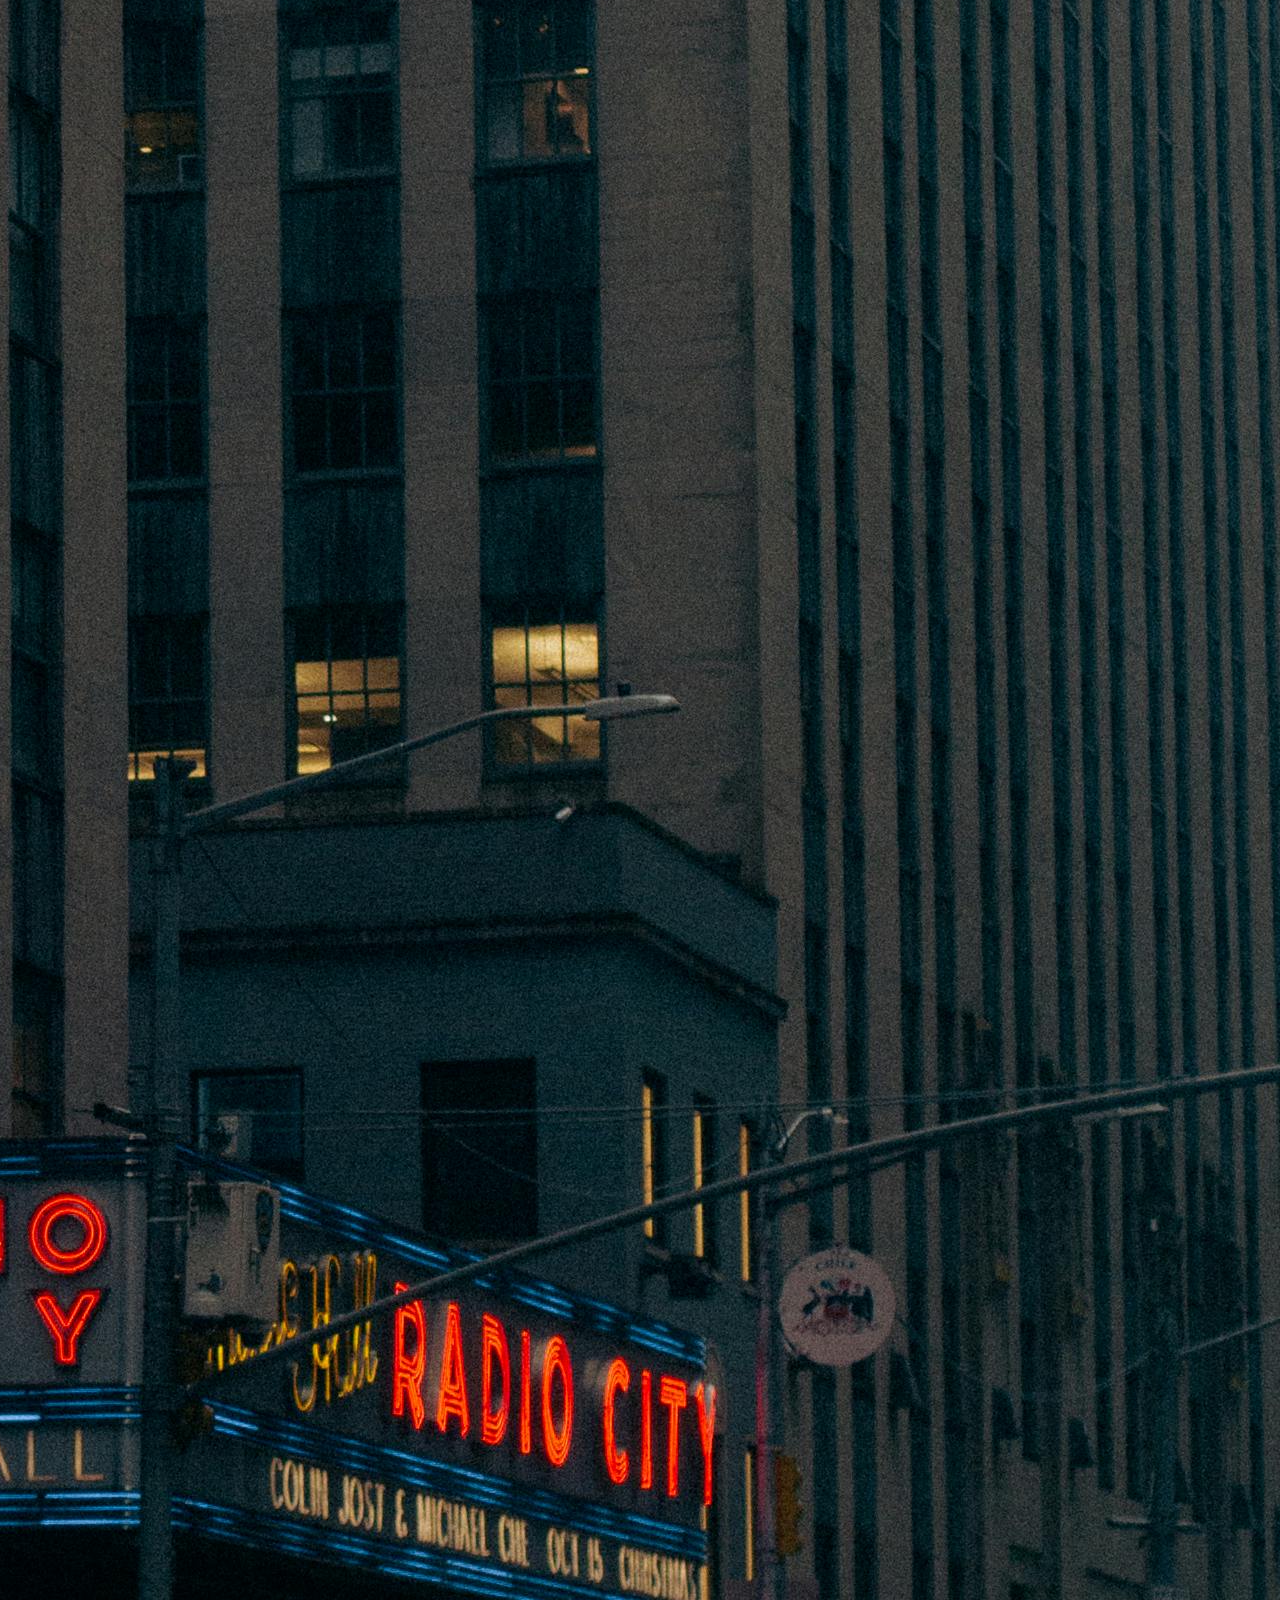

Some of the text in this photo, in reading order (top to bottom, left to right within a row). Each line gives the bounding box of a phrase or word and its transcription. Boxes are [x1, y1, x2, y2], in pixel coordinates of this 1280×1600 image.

[391, 1281, 575, 1468] RADIO
[602, 1356, 717, 1507] CITY
[269, 1456, 330, 1521] COLIN
[337, 1473, 385, 1534] JOST
[416, 1488, 490, 1557] MICHAEL
[497, 1512, 530, 1568] CHE
[546, 1527, 580, 1578] OCT
